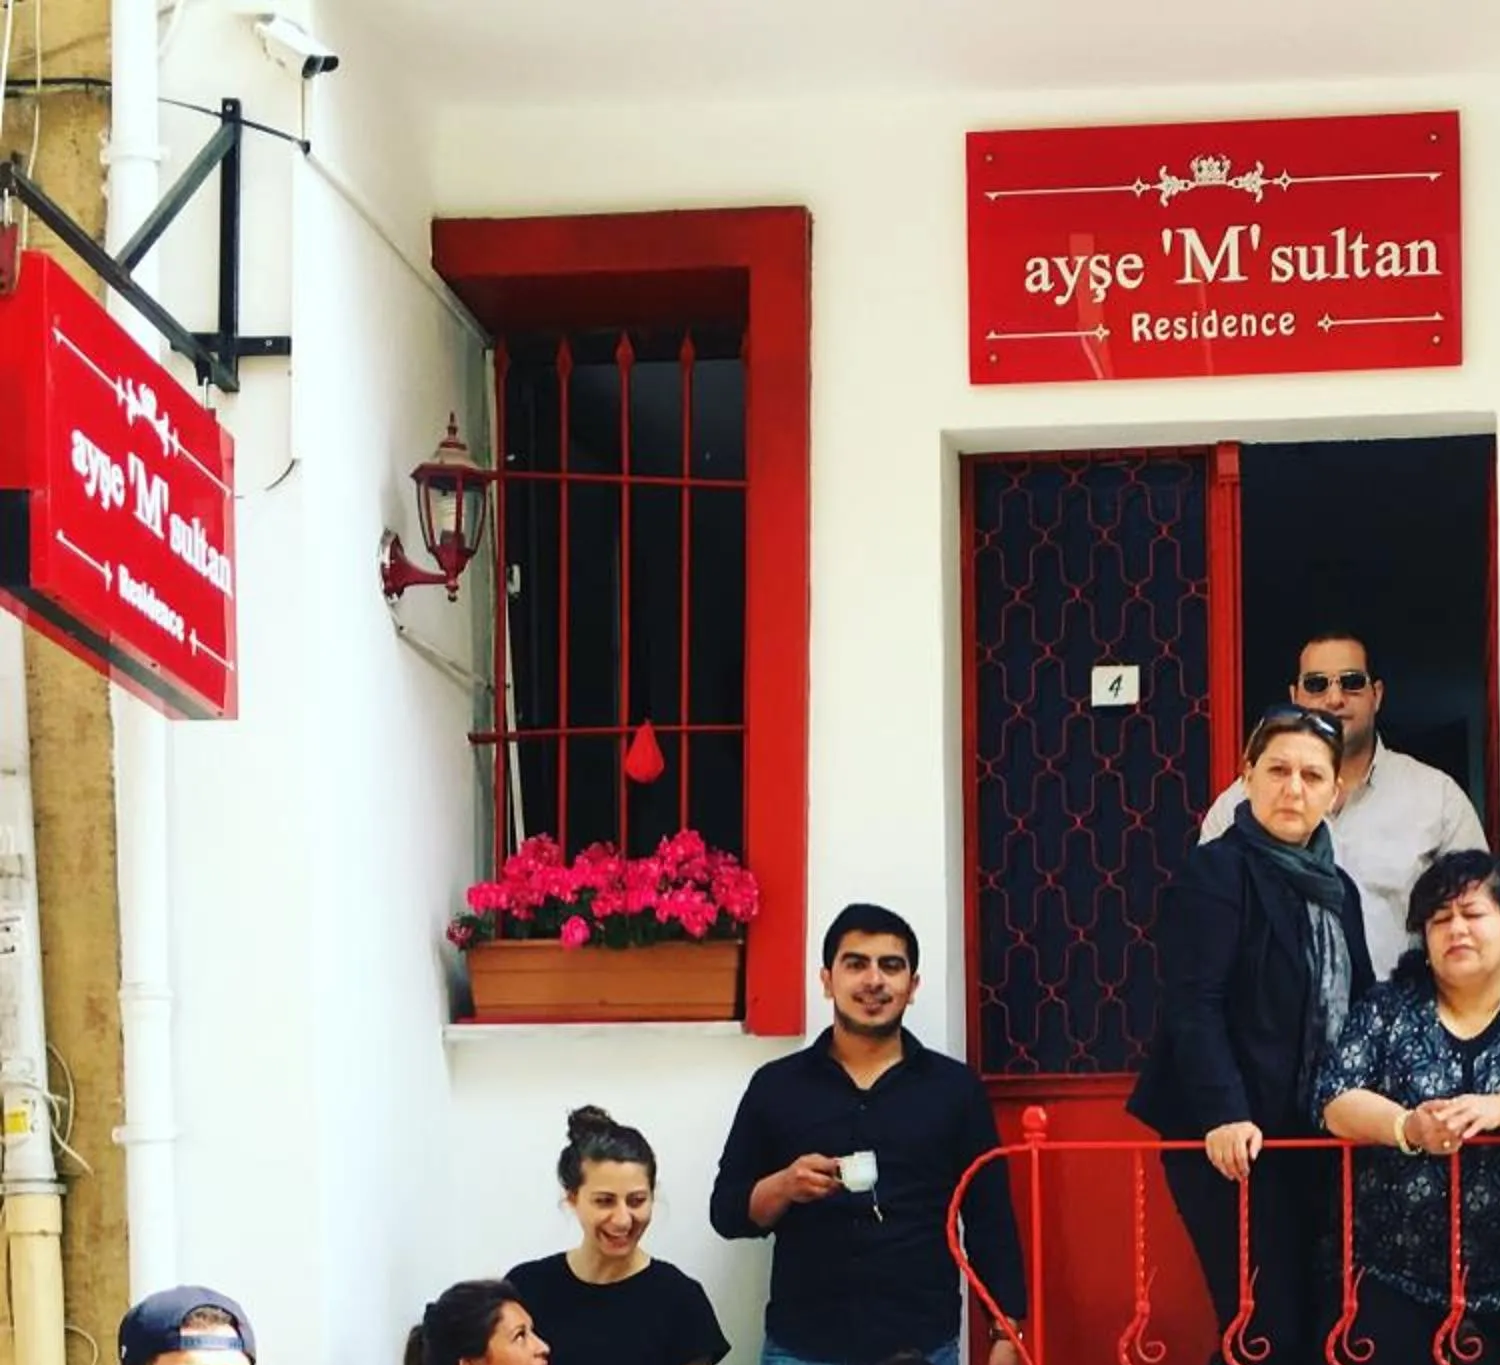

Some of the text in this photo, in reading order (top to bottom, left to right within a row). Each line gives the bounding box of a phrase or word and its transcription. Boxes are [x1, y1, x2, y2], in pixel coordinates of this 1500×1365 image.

[1025, 253, 1144, 305] ayşe
[1271, 228, 1442, 283] sultan
[1131, 310, 1295, 342] Residence
[1108, 674, 1122, 698] 4
